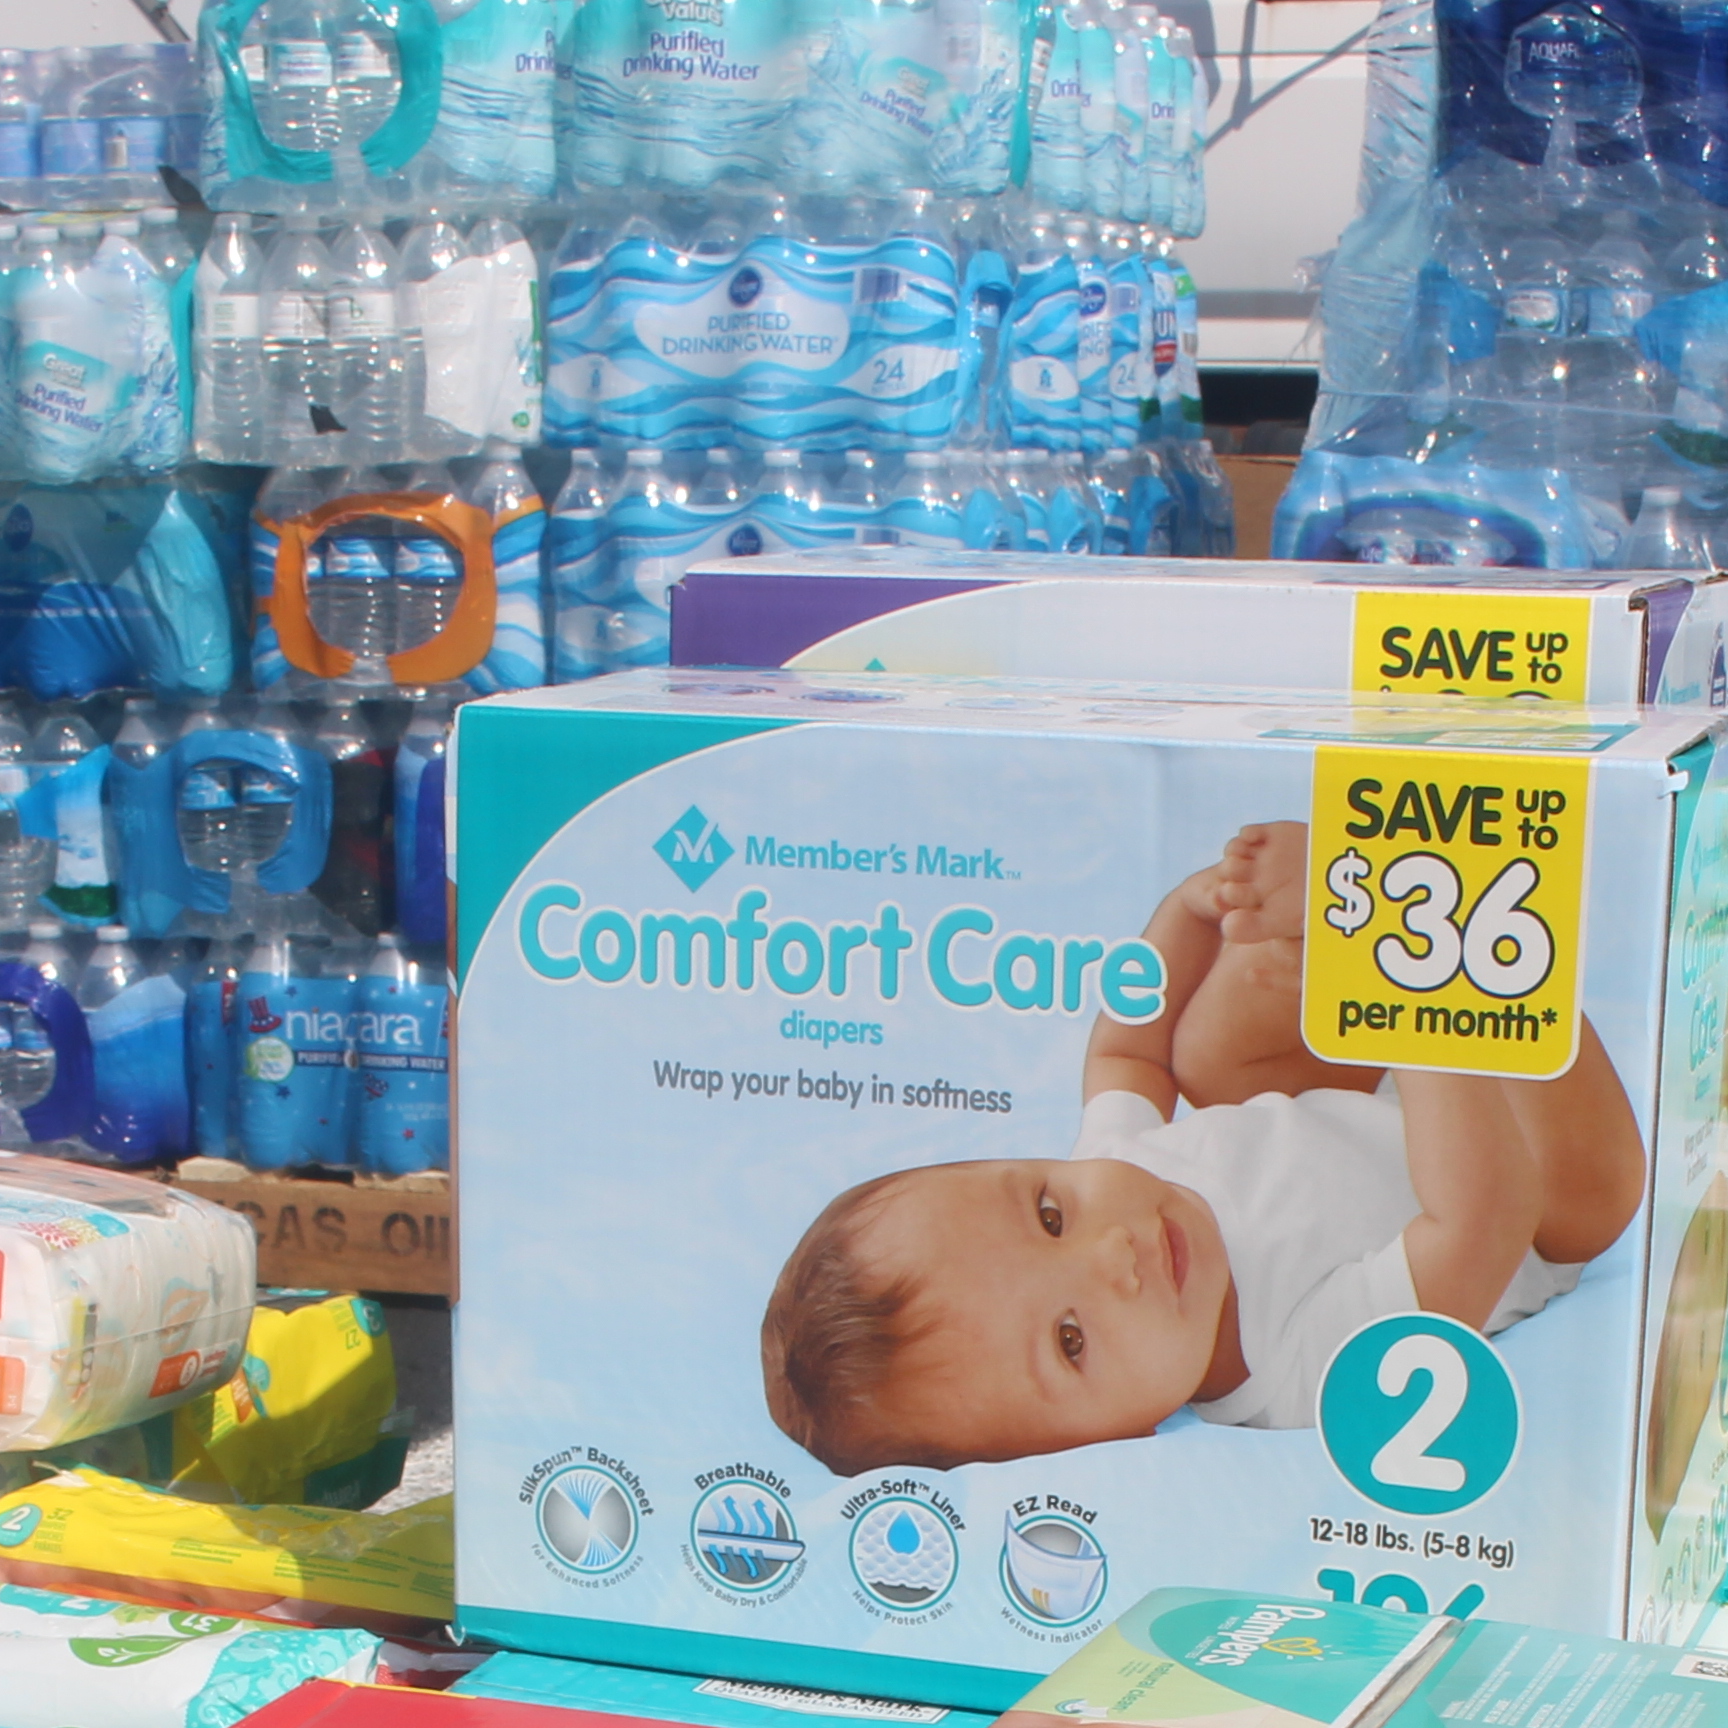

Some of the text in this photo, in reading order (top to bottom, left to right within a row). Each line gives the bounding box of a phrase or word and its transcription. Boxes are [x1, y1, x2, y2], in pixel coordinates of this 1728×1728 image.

[650, 30, 725, 57] Purified
[700, 54, 761, 81] Water
[708, 312, 791, 334] PURIFIED
[874, 358, 905, 384] 24
[1380, 626, 1569, 682] SAVE up
[1528, 654, 1562, 684] to
[1345, 778, 1566, 845] SAVE up
[744, 834, 908, 875] Member's
[1518, 819, 1559, 851] to
[1324, 848, 1556, 1000] $36
[518, 882, 1165, 1018] Comfort Care
[779, 1010, 884, 1048] diapers
[1338, 999, 1405, 1036] per
[652, 1060, 1012, 1113] Wrap your baby in softness
[1371, 1333, 1469, 1493] 2
[587, 1447, 655, 1517] Backsheet
[693, 1461, 792, 1500] Breathable
[929, 1490, 966, 1532] Liner
[1012, 1494, 1098, 1525] EZ Read
[1310, 1518, 1515, 1569] 12-18 lbs. (5-8 kg)
[852, 1588, 954, 1627] Helps Protect Skin
[1000, 1606, 1104, 1644] Wetness Indicator
